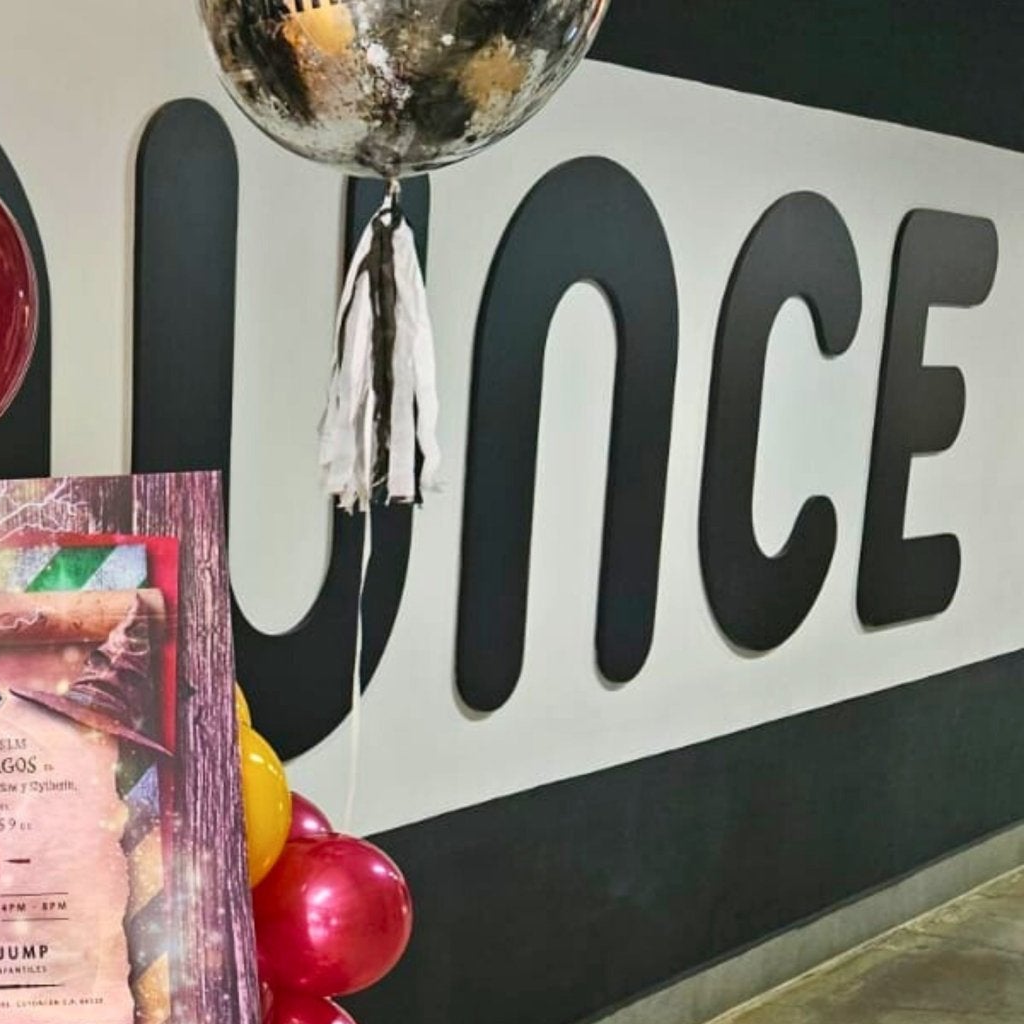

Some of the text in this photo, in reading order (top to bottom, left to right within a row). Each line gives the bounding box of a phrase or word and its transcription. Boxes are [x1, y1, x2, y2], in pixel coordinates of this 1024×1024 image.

[8, 817, 17, 830] 9
[1, 902, 26, 913] 4PM
[41, 901, 67, 911] 8PM
